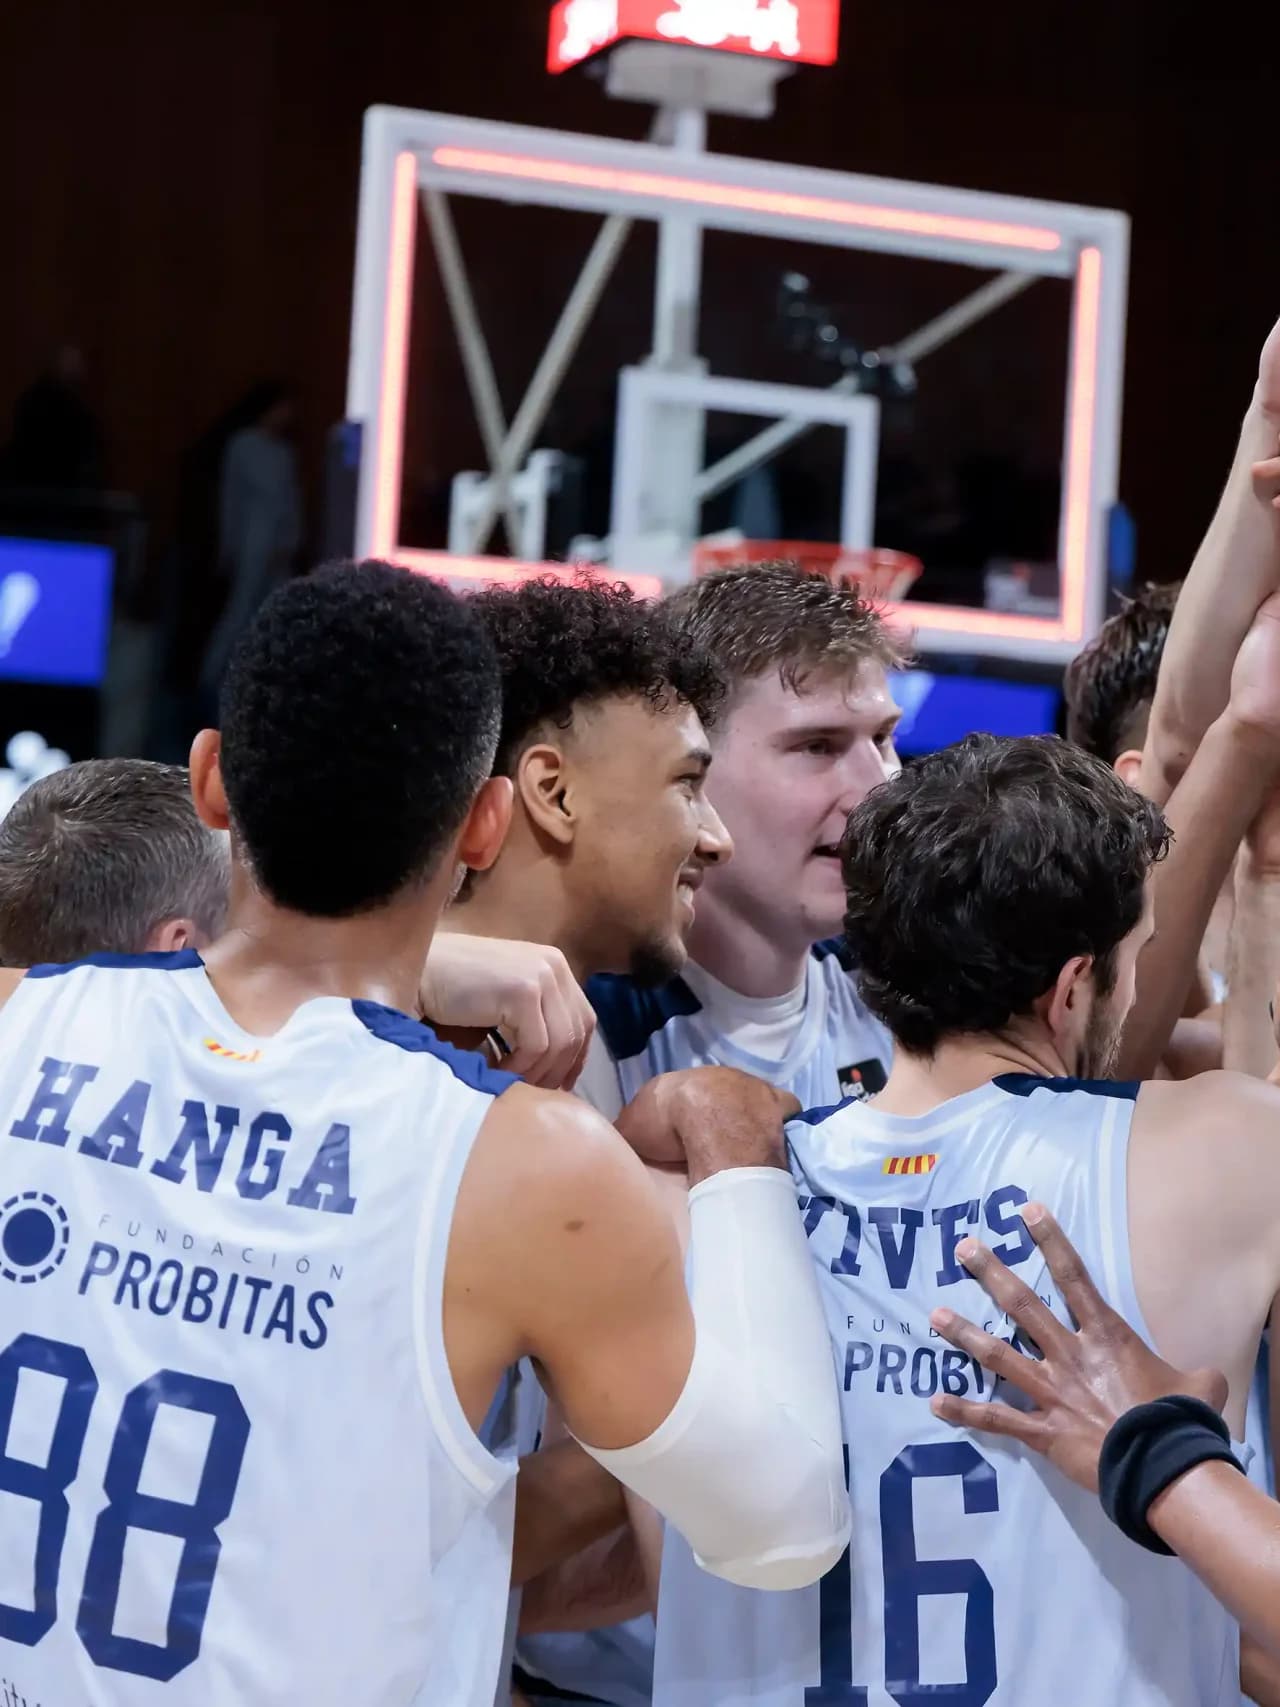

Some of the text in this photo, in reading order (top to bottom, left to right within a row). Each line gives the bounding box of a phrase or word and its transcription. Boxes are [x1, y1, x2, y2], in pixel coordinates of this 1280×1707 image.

[9, 1056, 357, 1215] HANGA
[77, 1240, 335, 1350] PROBITAS
[98, 1213, 345, 1281] FUNDACIÓN
[843, 1339, 1022, 1399] PROBI
[804, 1441, 999, 1707] 16
